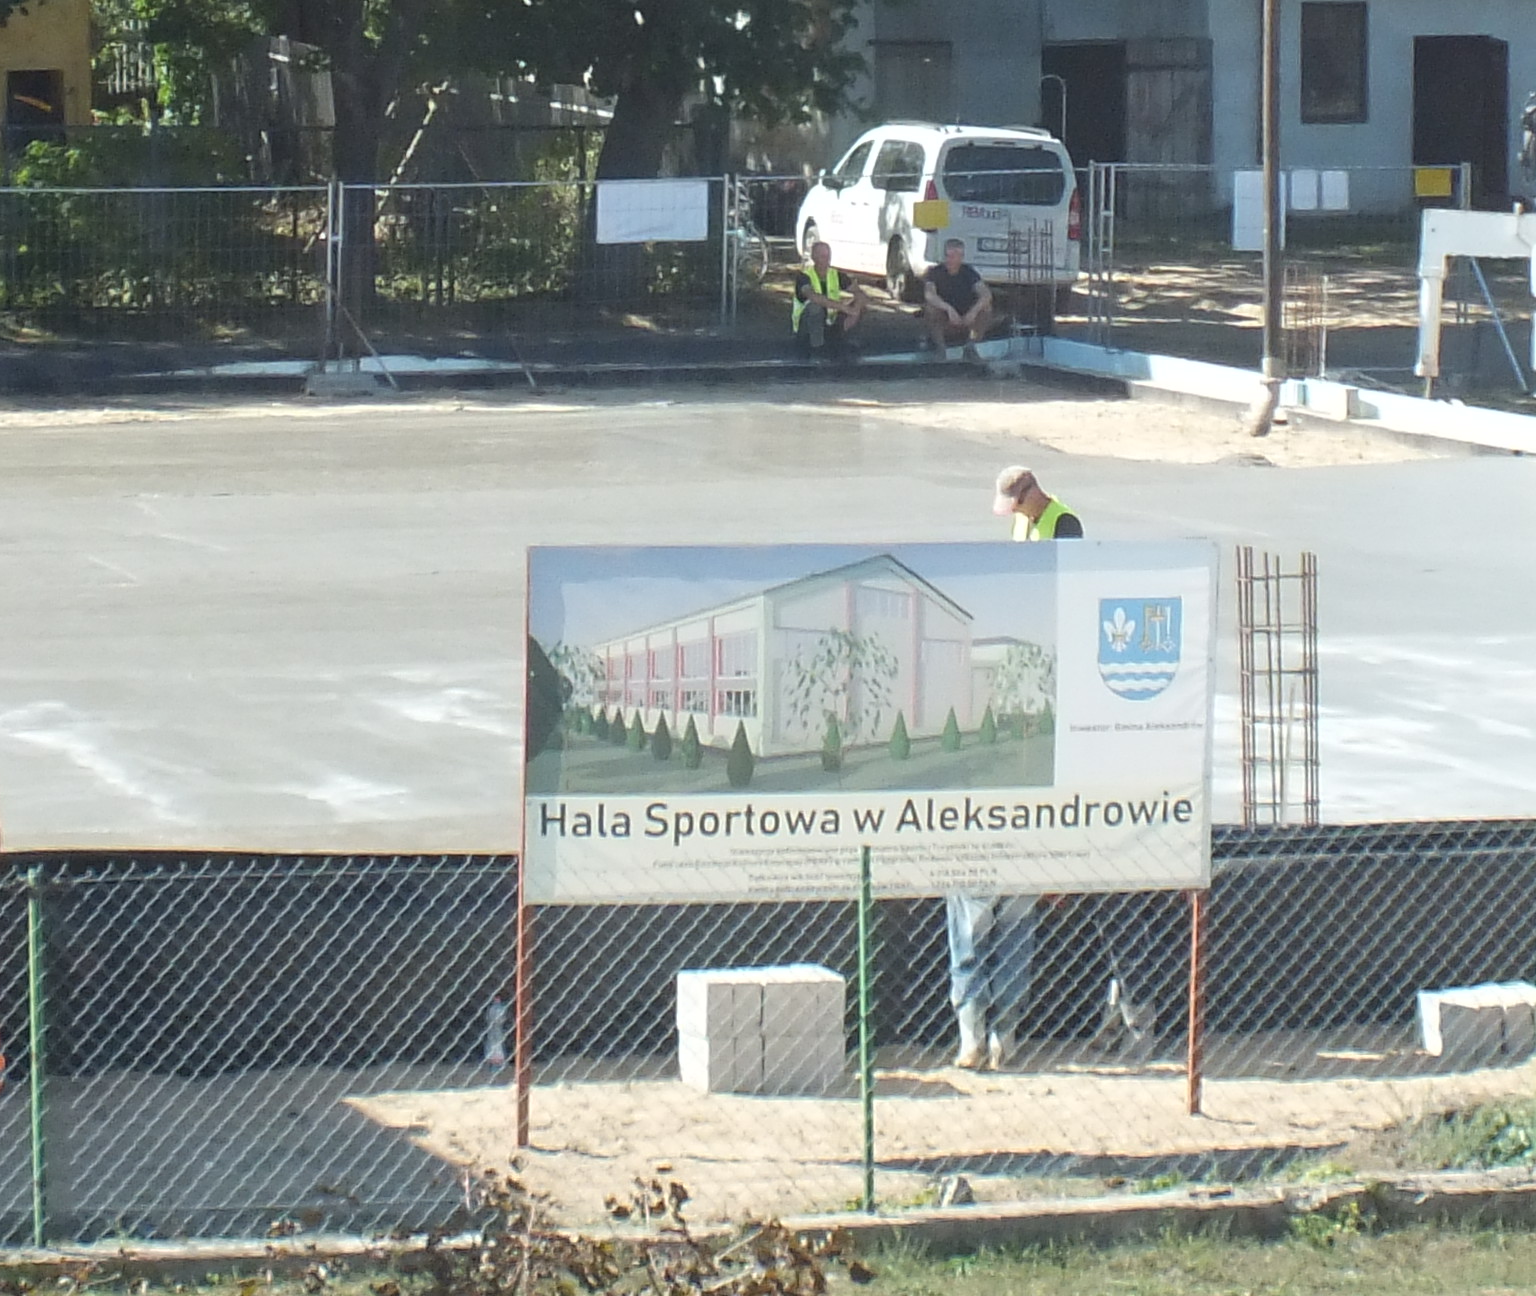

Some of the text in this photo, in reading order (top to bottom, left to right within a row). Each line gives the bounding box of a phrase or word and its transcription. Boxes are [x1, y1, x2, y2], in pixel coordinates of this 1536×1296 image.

[539, 791, 1194, 846] Hala Sportowa w Aleksandrowie
